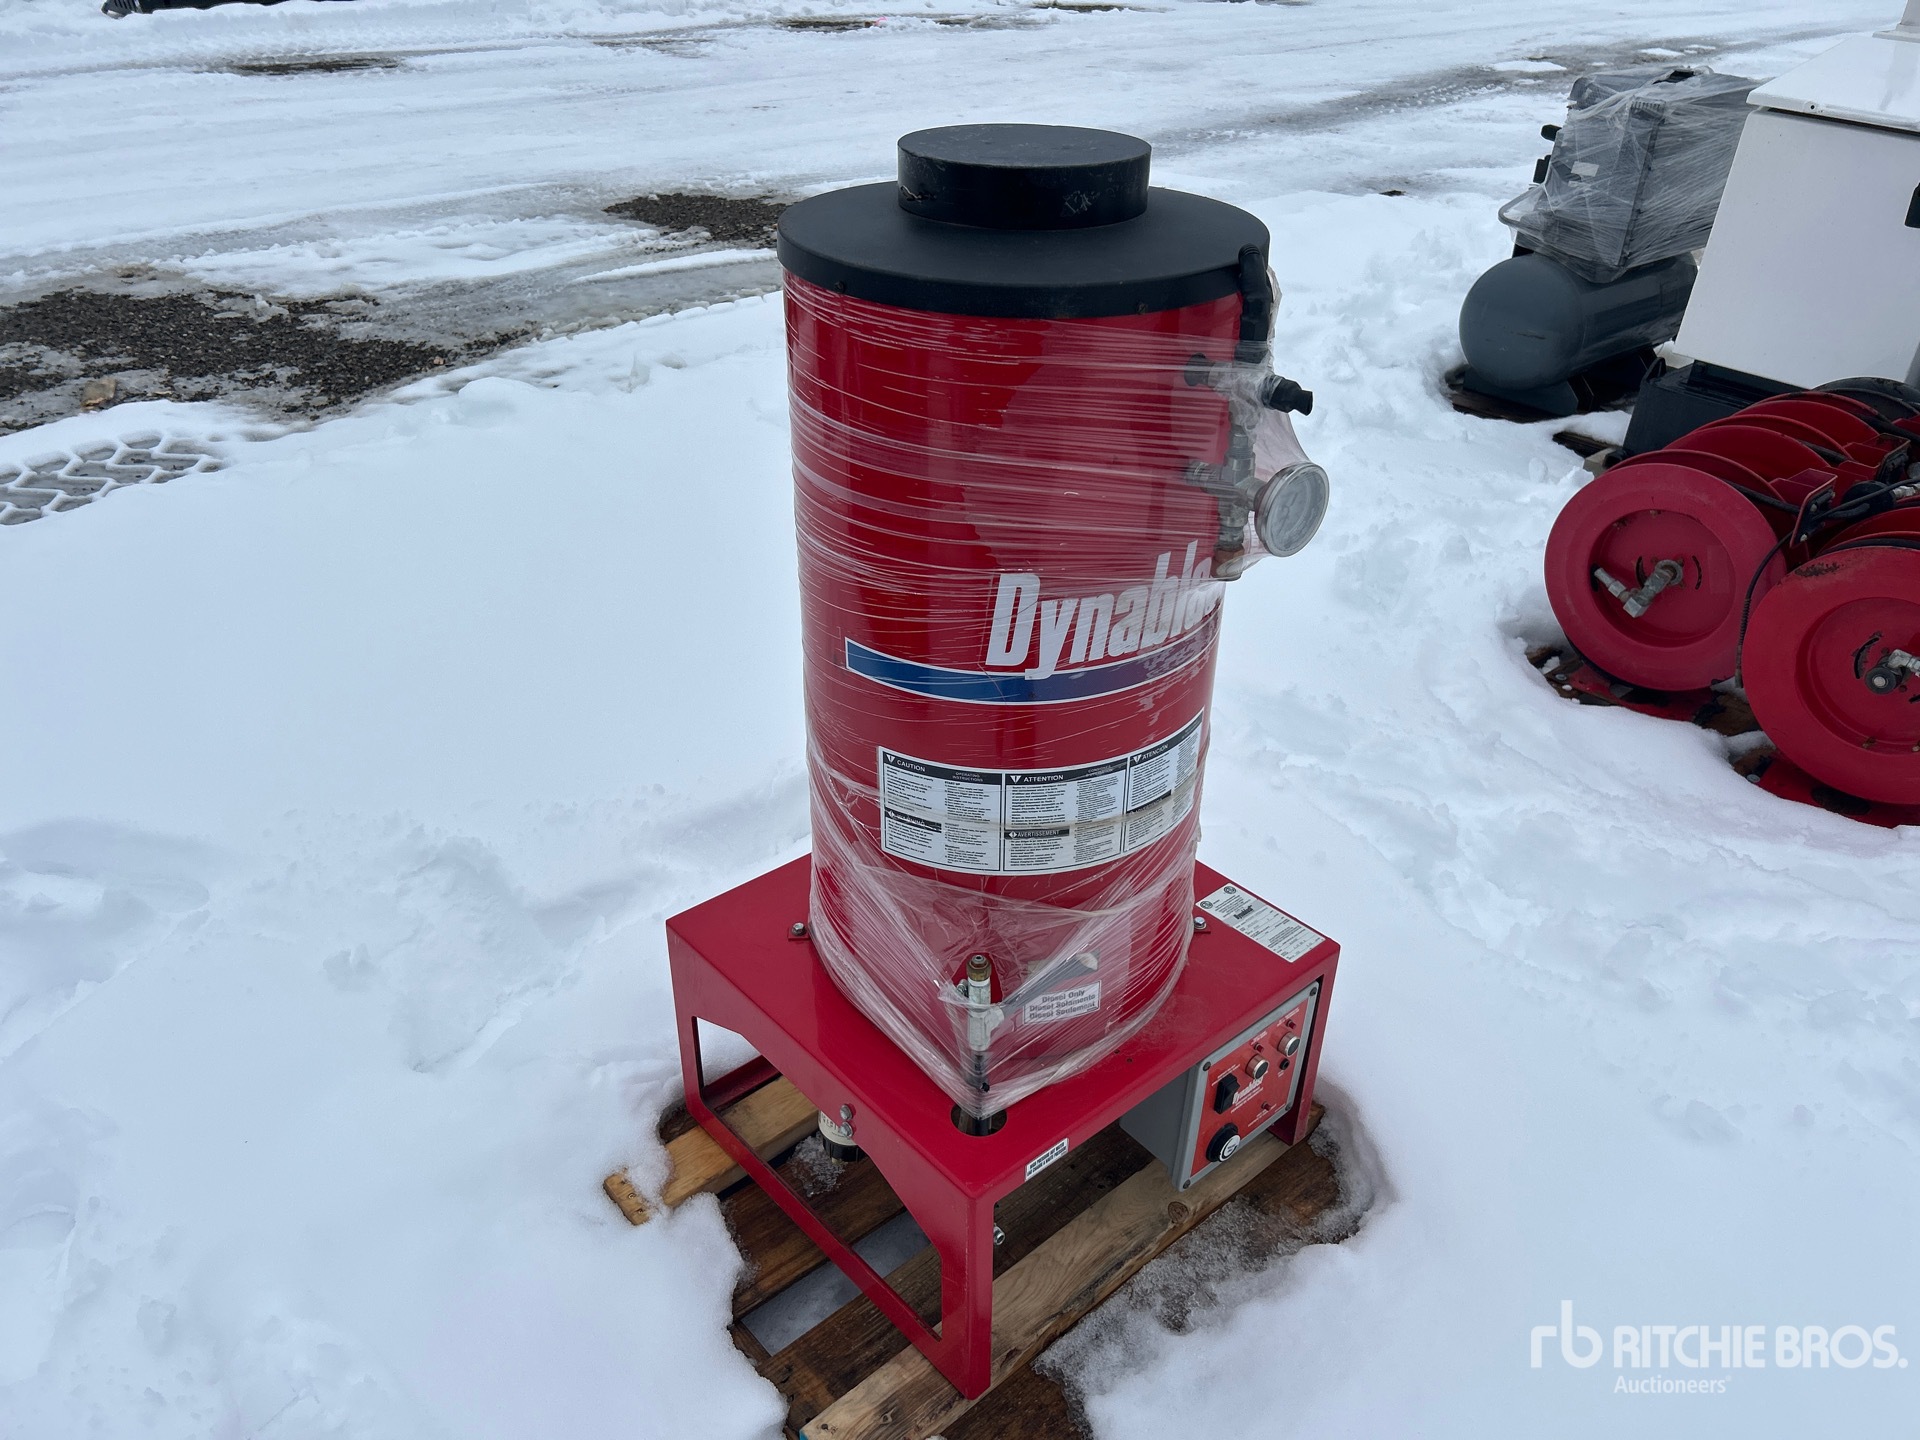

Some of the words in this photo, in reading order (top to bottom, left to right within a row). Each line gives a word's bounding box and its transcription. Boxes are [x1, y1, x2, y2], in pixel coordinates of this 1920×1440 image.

[897, 759, 926, 772] CAUTION
[1023, 774, 1064, 783] ATTENTION
[1017, 830, 1060, 838] AVERTISSEMENT
[1068, 989, 1085, 998] Only
